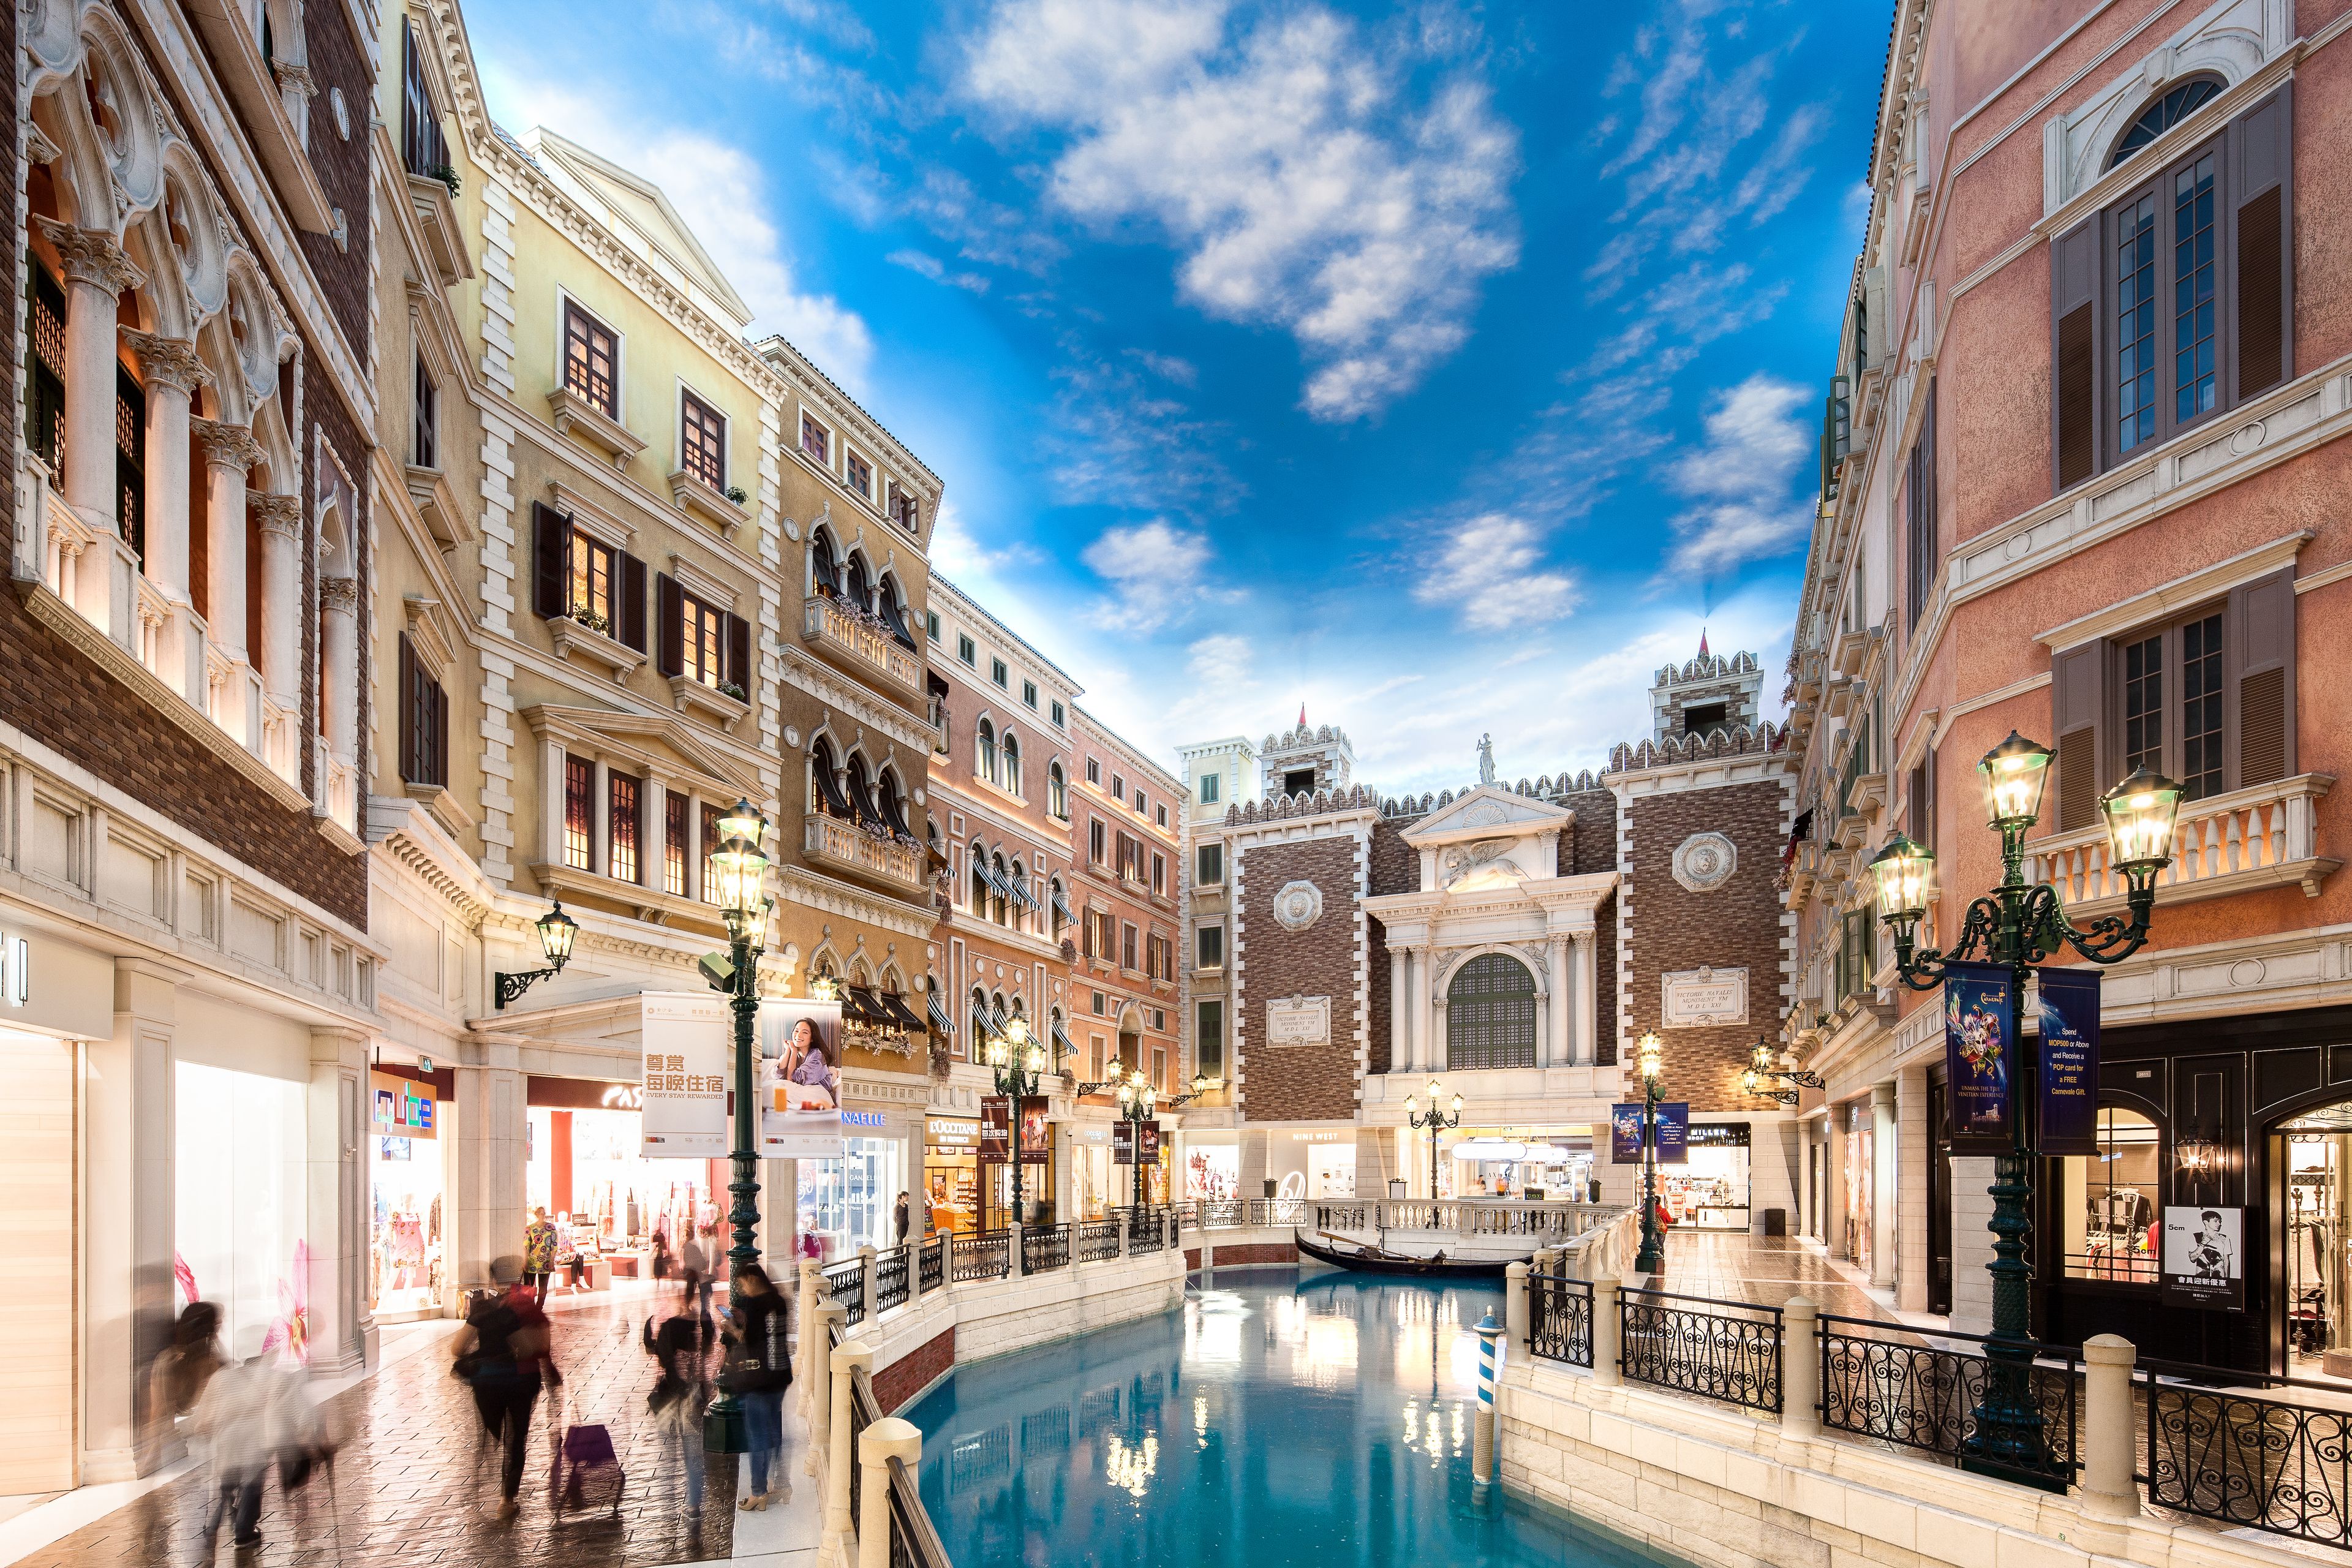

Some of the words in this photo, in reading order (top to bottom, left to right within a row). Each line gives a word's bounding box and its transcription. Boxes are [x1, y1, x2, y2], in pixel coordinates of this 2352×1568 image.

[646, 1054, 684, 1072] 尊赏
[646, 1074, 723, 1092] 每晚住宿
[374, 1082, 432, 1132] qube
[930, 1120, 978, 1134] L'OCCITANE
[2133, 1245, 2156, 1254] 5cm
[2178, 1276, 2227, 1286] 會員迎新優惠
